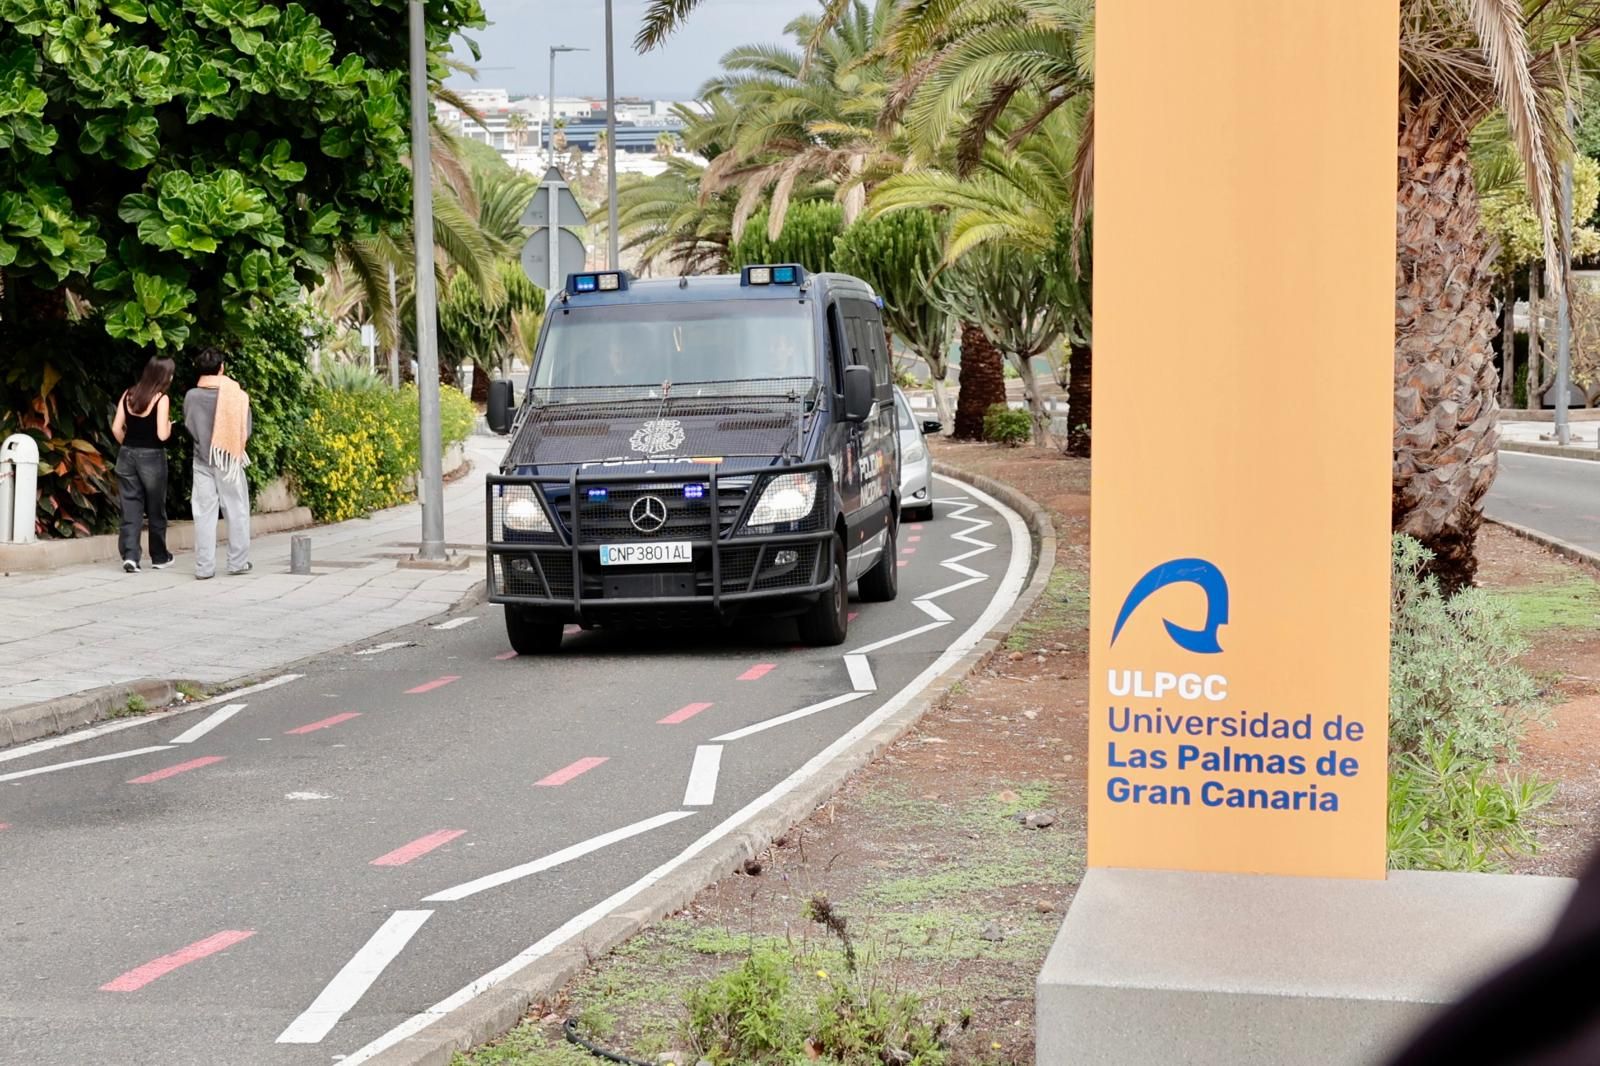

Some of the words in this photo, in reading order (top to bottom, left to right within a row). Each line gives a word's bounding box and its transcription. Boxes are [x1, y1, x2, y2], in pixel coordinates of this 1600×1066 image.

[1107, 669, 1228, 701] ULPGC
[1108, 706, 1312, 740] Universidad
[1322, 714, 1365, 742] de
[1107, 741, 1168, 770] Las
[1178, 744, 1306, 776] Palmas
[1316, 750, 1359, 777] de
[1106, 777, 1191, 806] Gran
[1201, 781, 1339, 812] Canaria
